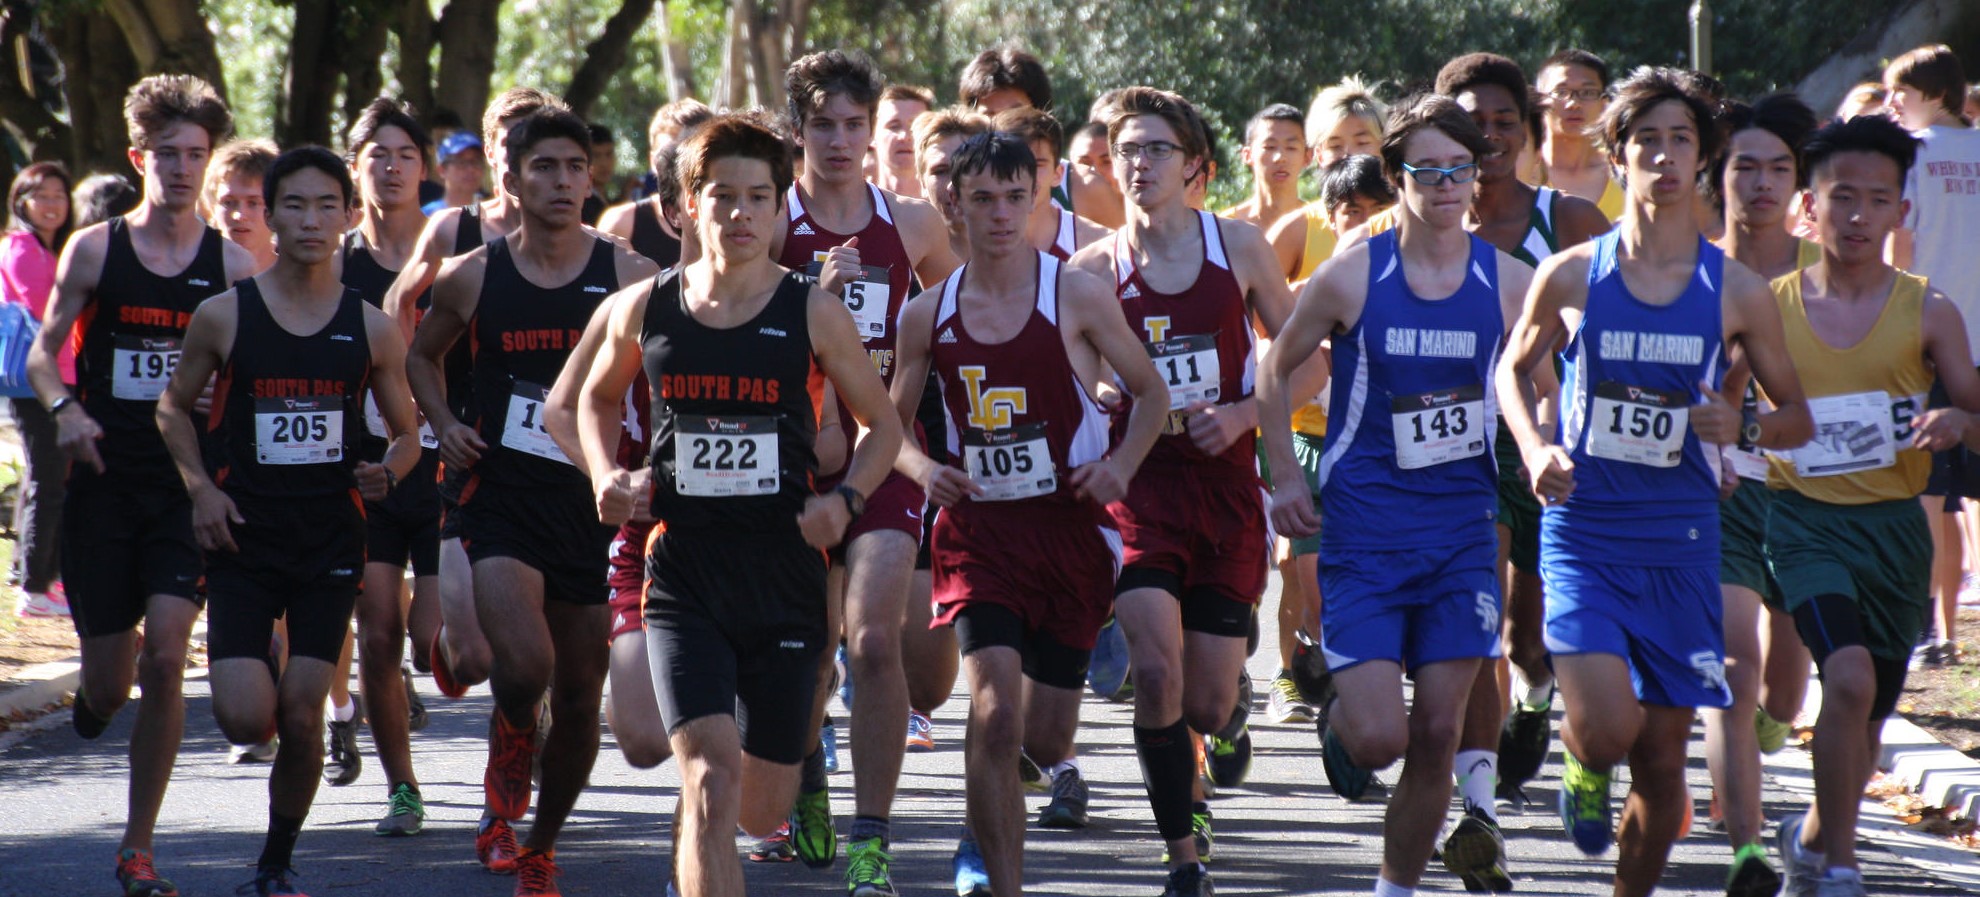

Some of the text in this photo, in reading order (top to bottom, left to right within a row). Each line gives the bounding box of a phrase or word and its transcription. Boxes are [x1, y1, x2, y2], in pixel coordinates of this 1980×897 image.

[844, 282, 866, 312] 5
[119, 304, 173, 328] SOUTH
[501, 328, 564, 353] SOUTH
[1385, 326, 1478, 359] SAN MARINO
[1600, 329, 1705, 366] SAN MARINO
[128, 353, 180, 379] 195
[1151, 354, 1202, 387] 11
[253, 378, 346, 398] SOUTH PAS
[661, 373, 780, 404] SOUTH PAS
[272, 414, 328, 443] 205
[521, 402, 548, 434] 1
[1411, 406, 1469, 443] 143
[1609, 403, 1674, 441] 150
[692, 437, 758, 470] 222
[977, 444, 1034, 477] 105
